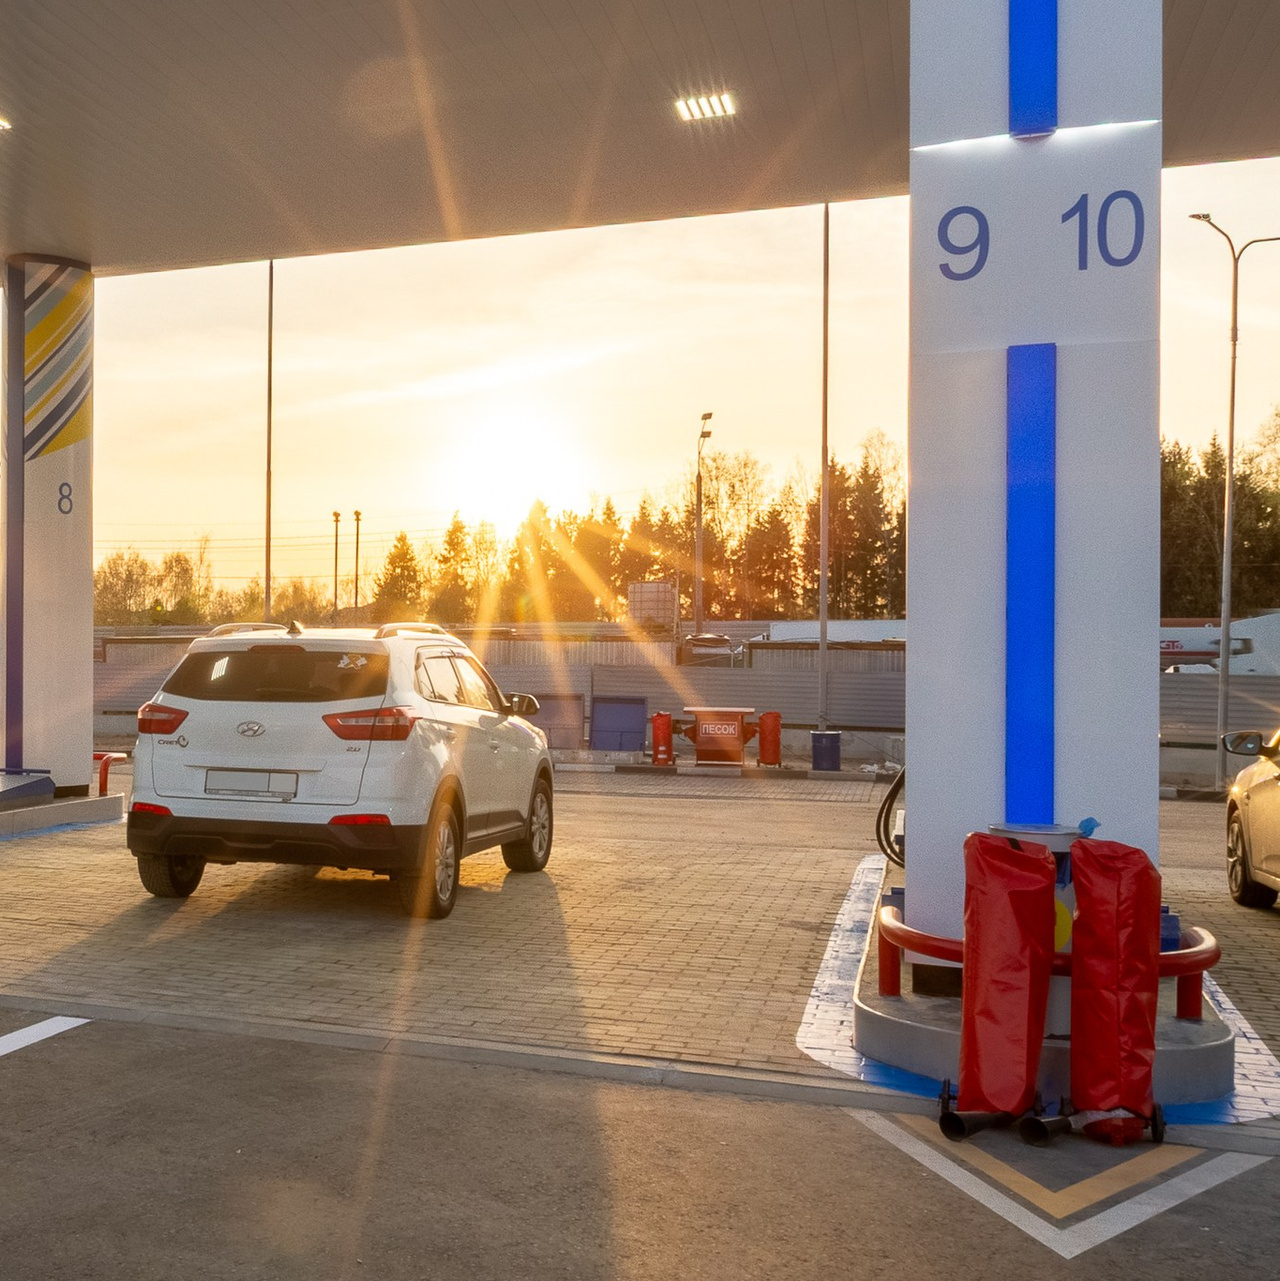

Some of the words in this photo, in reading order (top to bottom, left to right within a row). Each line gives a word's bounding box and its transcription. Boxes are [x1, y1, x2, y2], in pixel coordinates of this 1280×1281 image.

[937, 205, 991, 282] 9
[1061, 189, 1145, 271] 10
[58, 482, 73, 515] 8
[702, 724, 736, 735] ПЕСОК
